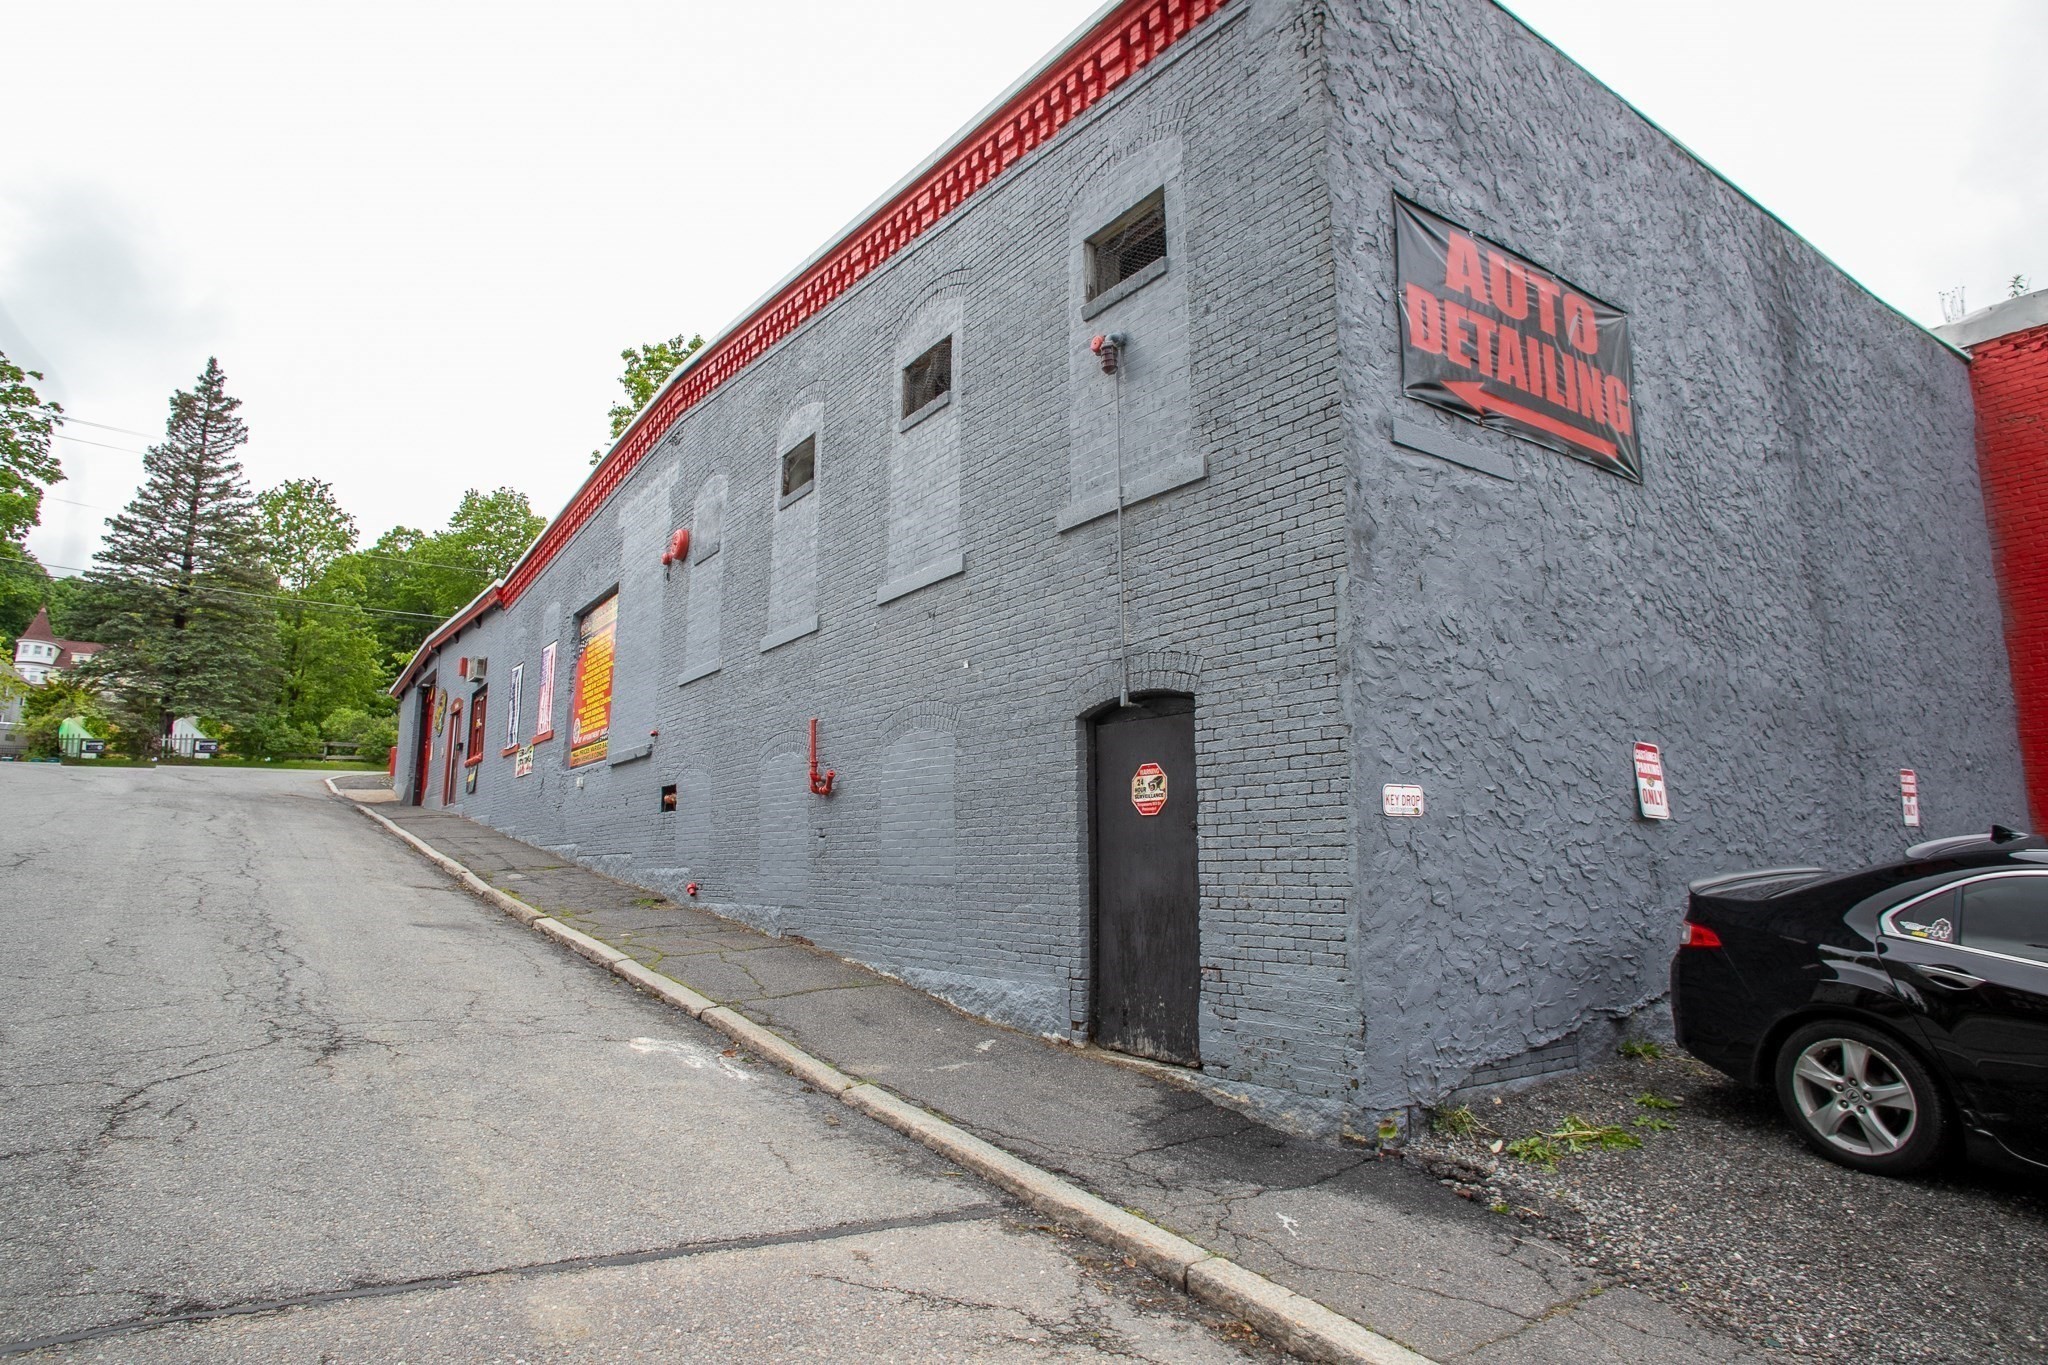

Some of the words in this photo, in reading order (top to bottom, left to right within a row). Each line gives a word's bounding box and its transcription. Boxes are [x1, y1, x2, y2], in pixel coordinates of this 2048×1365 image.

[1445, 231, 1599, 355] AUTO
[1406, 282, 1631, 436] DETAILING
[1136, 778, 1144, 787] 24
[1134, 792, 1164, 800] SURVEILLANCE
[1385, 794, 1399, 806] KEY
[1401, 794, 1420, 807] DROP
[1642, 788, 1663, 806] ONLY
